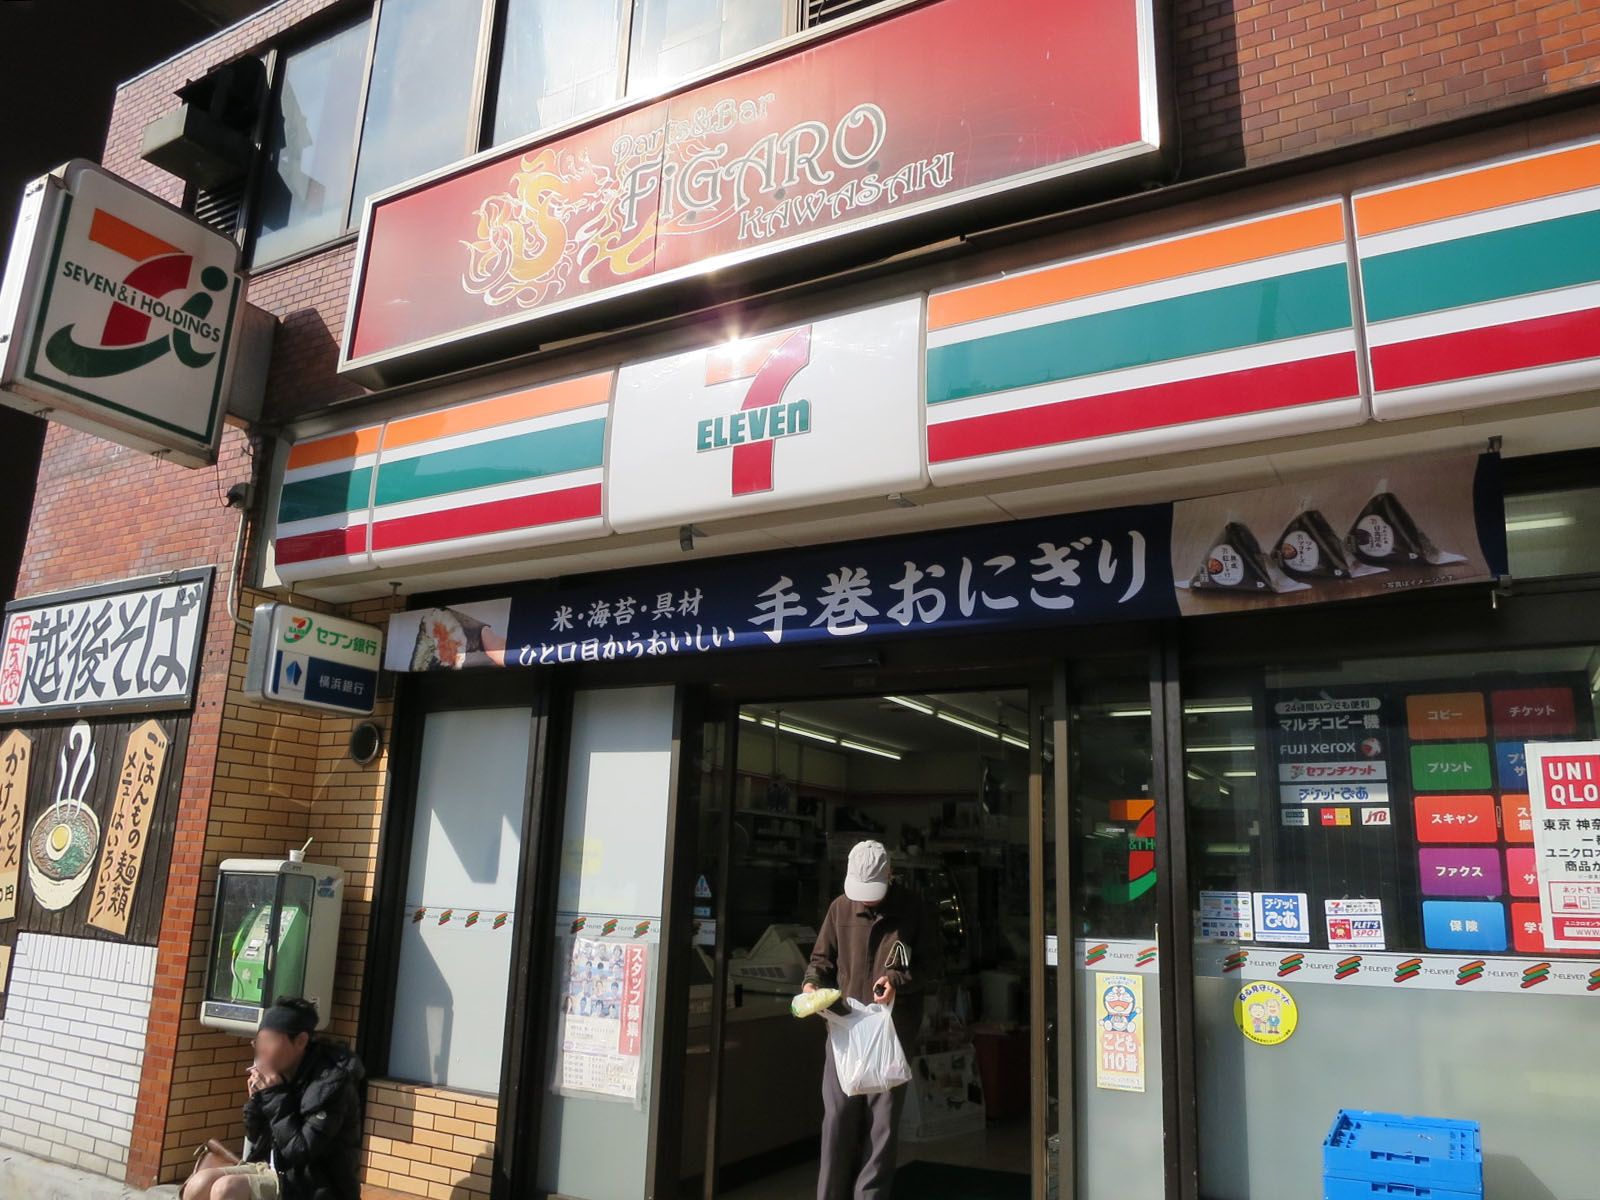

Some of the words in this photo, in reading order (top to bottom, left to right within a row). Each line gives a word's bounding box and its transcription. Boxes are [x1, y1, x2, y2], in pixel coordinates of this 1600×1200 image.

[738, 151, 954, 241] KAWASAKI
[141, 294, 221, 344] HOLDINGS
[747, 529, 1147, 644] 手巻おにぎり
[551, 587, 705, 632] 米・海苔・具材
[17, 583, 202, 703] 越後そば
[518, 624, 737, 667] ひと口目からおいしい
[320, 674, 364, 695] 横浜銀行
[1508, 706, 1555, 717] チケット
[1280, 714, 1380, 731] マルチコピー機
[1280, 744, 1308, 755] FUJI
[1311, 742, 1356, 754] xerox
[1306, 765, 1376, 777] セブンチケット
[1427, 762, 1473, 773] プリント
[1548, 762, 1593, 781] UNI
[1299, 786, 1369, 800] チケットぴあ
[1551, 784, 1599, 806] QLO
[1431, 813, 1479, 824] スキャン
[1544, 818, 1572, 831] 東京
[4, 804, 21, 868] うどん
[1435, 866, 1483, 877] ファクス
[1264, 898, 1298, 911] チケット
[1265, 911, 1299, 929] ぴあ
[1354, 921, 1379, 929] FLET'S
[1448, 919, 1479, 933] 保険
[1356, 929, 1379, 937] SPOT
[1103, 1032, 1137, 1054] こども
[1103, 1053, 1138, 1073] 110番
